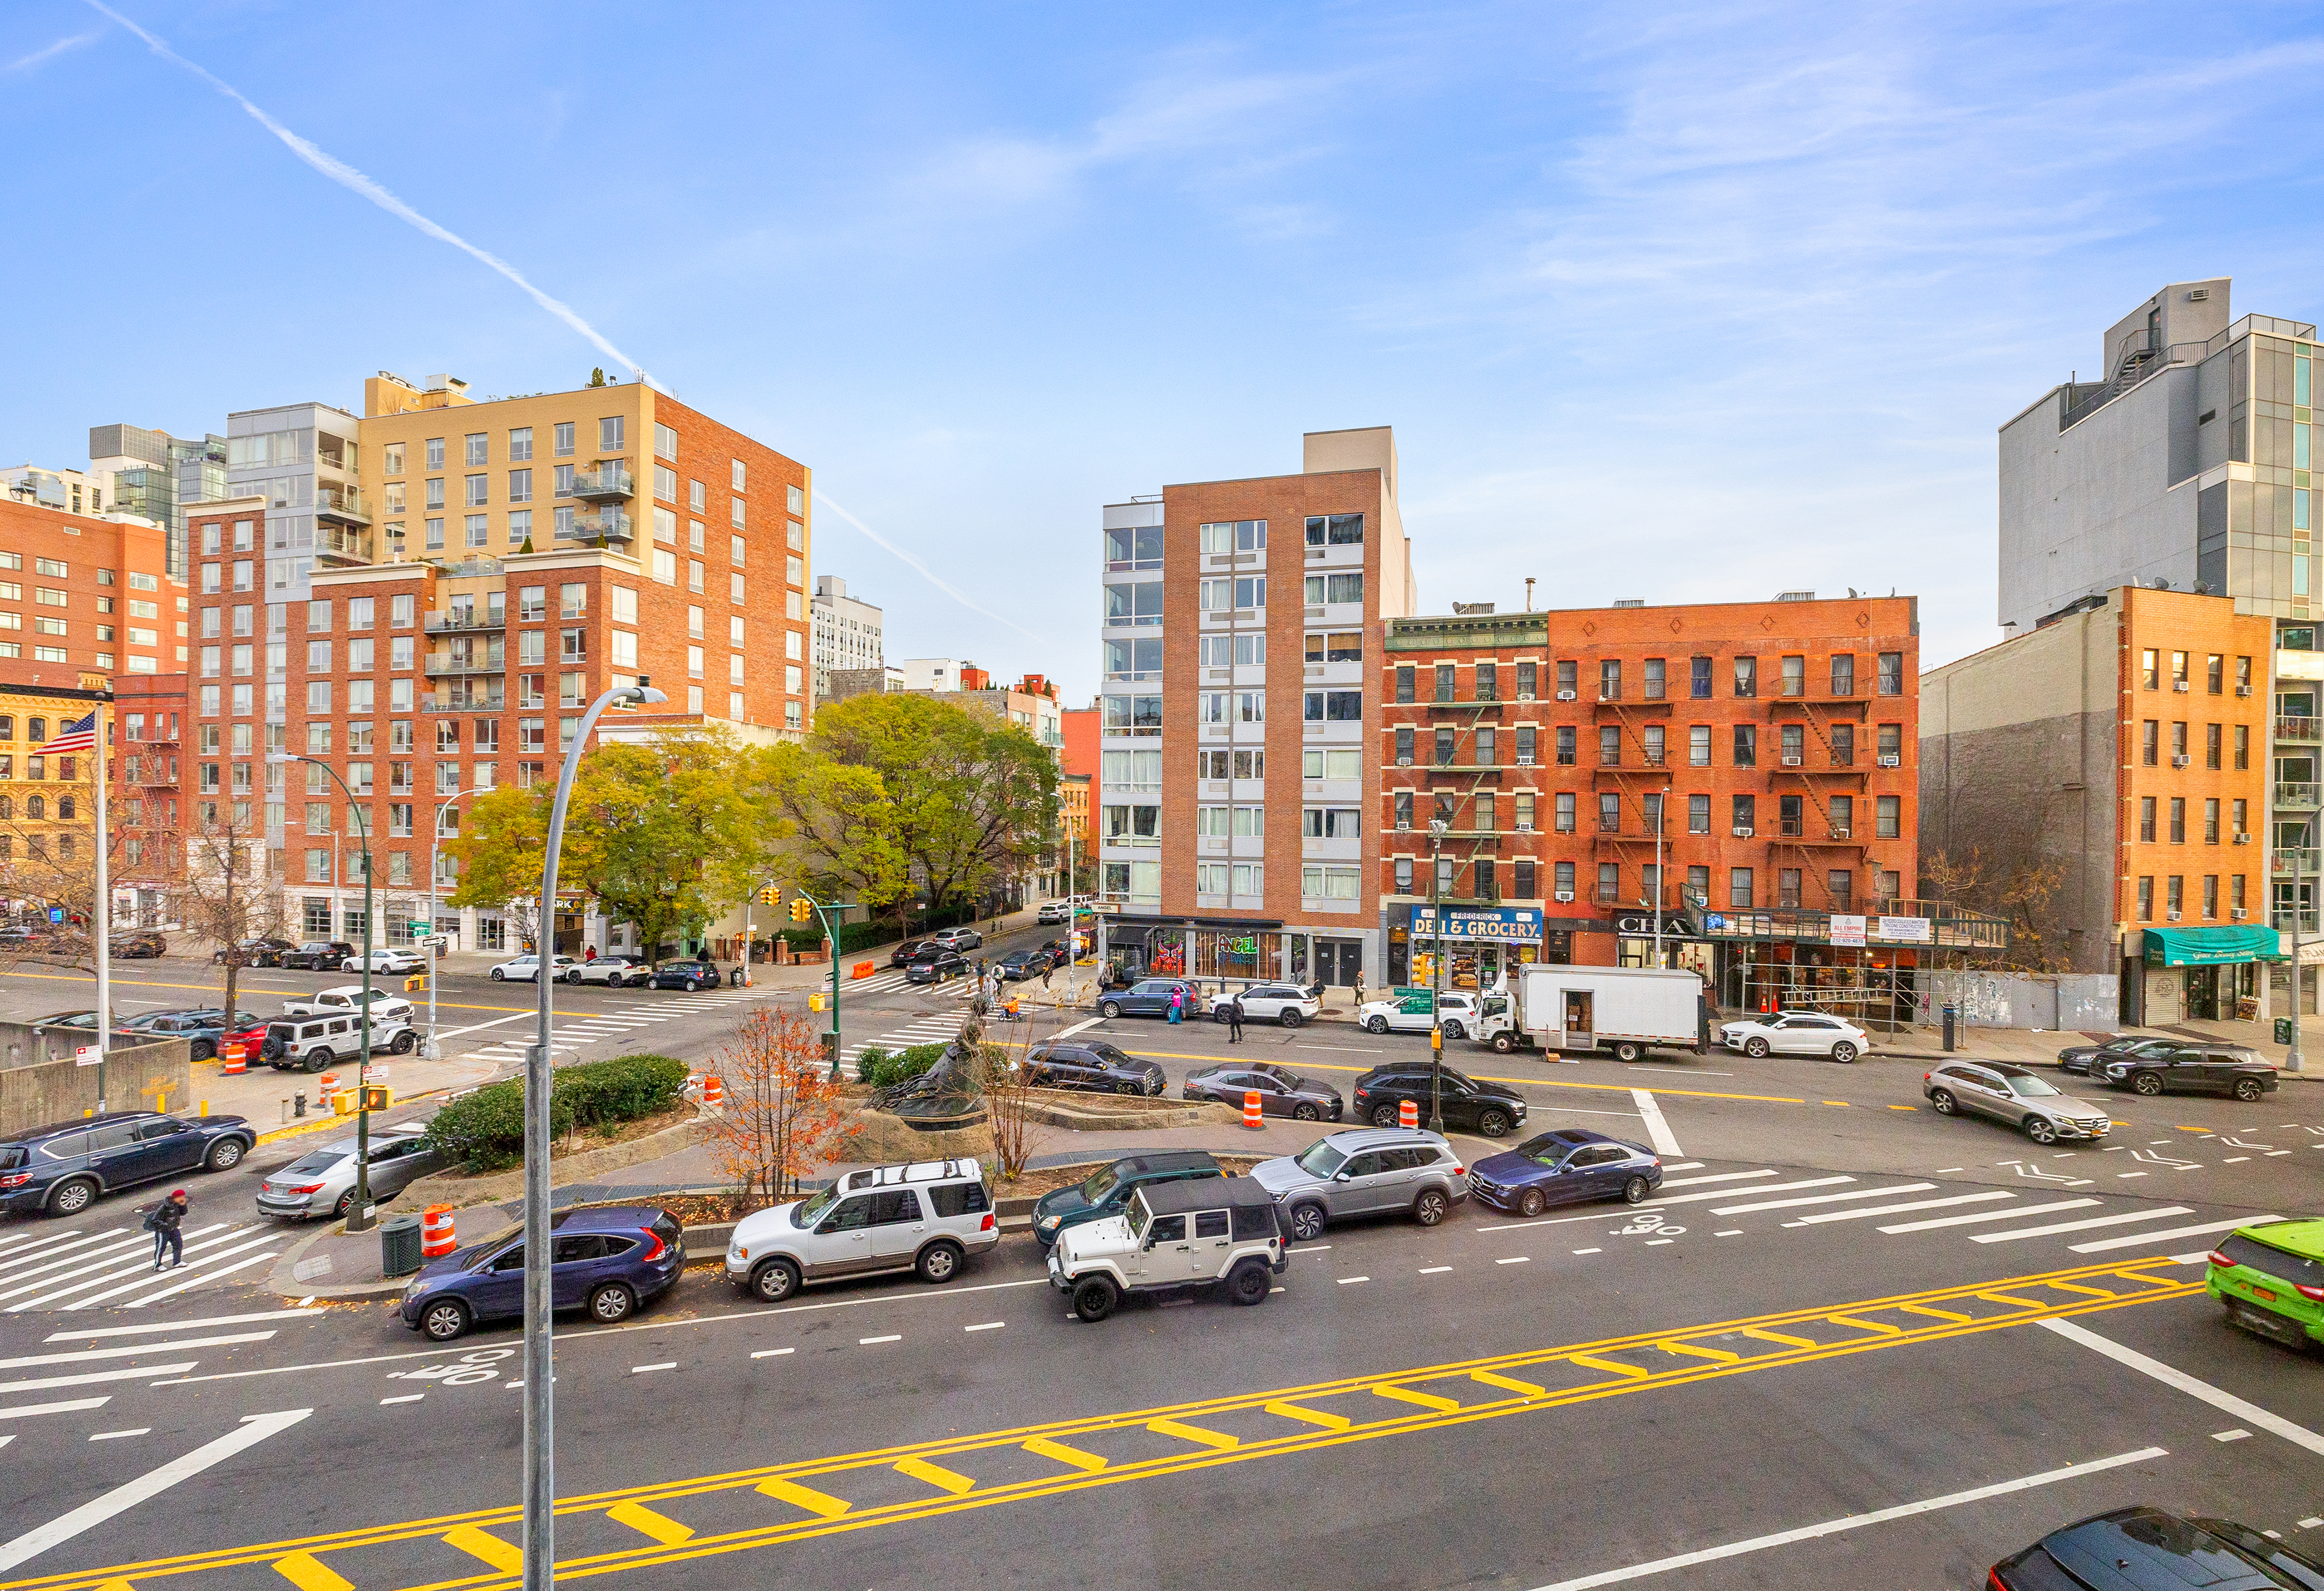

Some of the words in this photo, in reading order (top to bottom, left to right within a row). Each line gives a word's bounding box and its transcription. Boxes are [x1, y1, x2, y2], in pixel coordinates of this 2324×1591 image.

[1451, 921, 1463, 934] &
[1467, 921, 1538, 938] GROCERY
[1218, 934, 1257, 954] ANGEL
